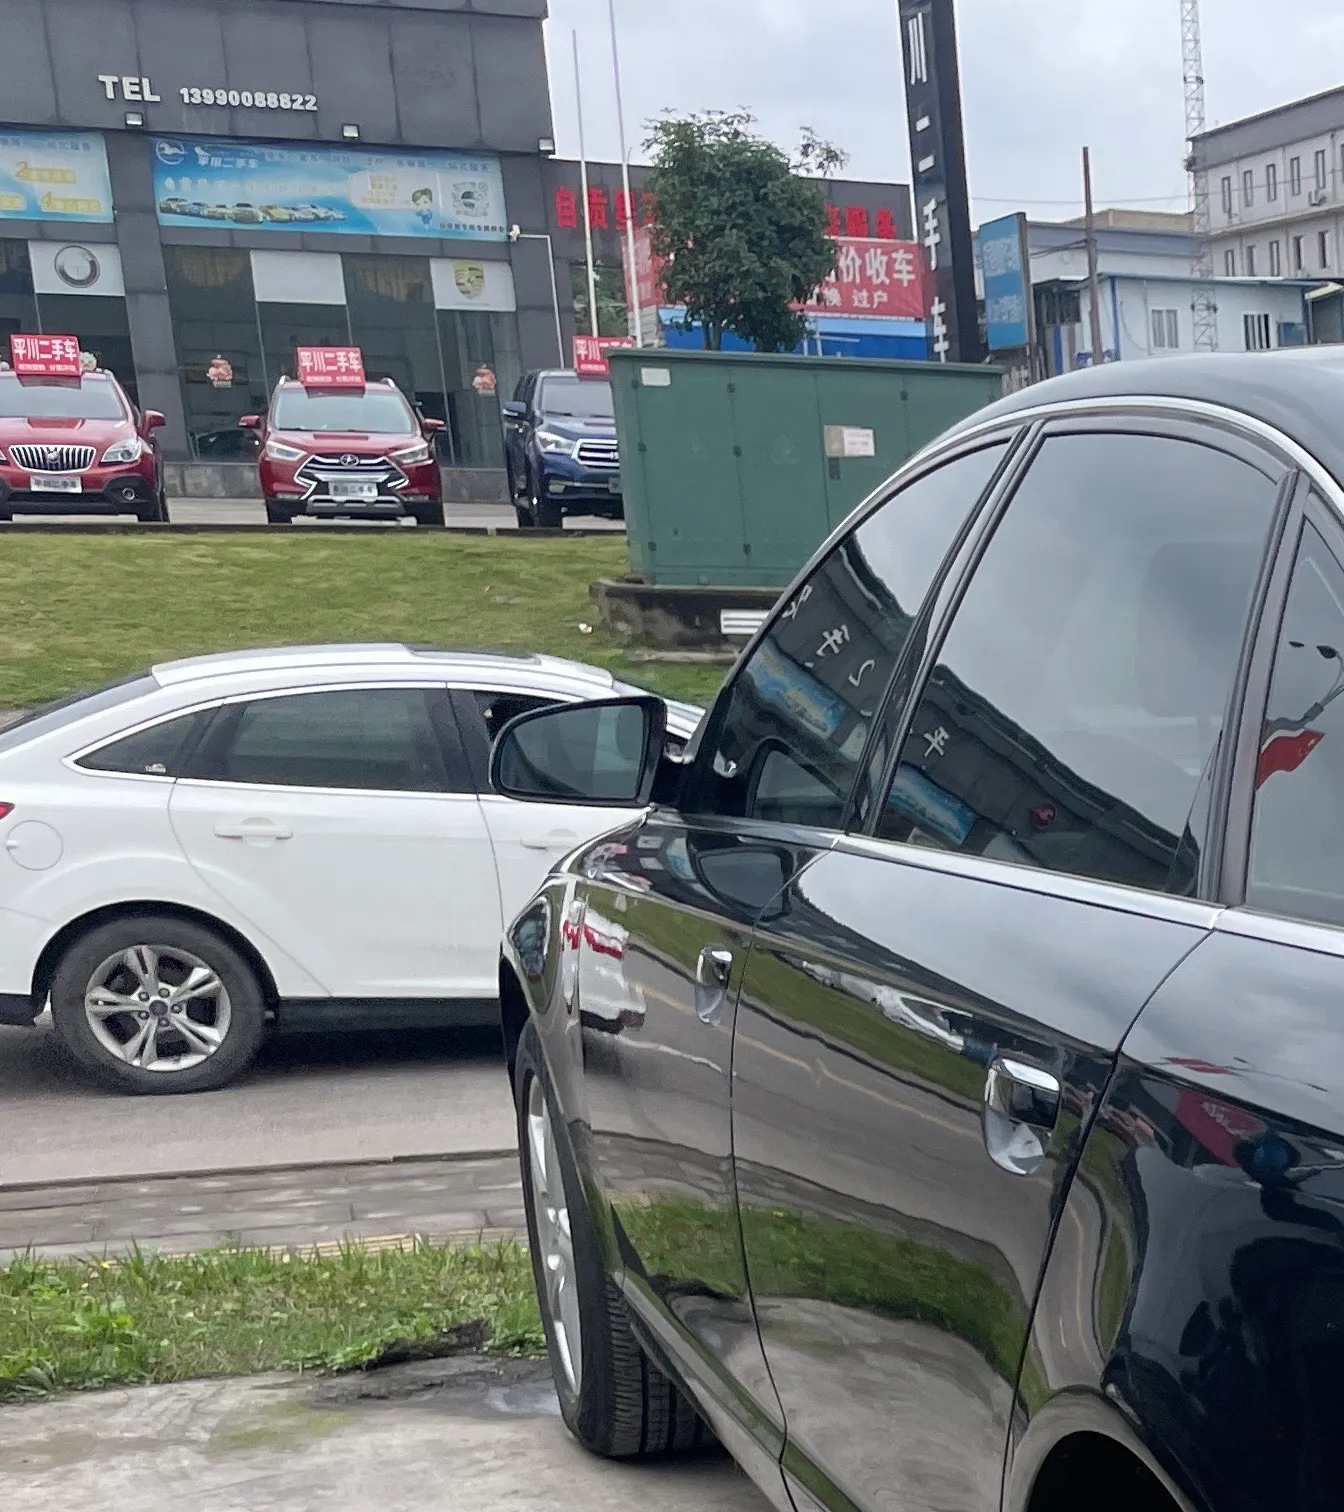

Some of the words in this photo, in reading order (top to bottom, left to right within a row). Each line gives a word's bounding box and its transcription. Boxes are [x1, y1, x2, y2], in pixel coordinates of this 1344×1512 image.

[98, 74, 161, 102] TEL
[179, 87, 318, 111] 13990088822
[12, 338, 78, 361] 平川二手车
[299, 351, 362, 372] 平川二手车
